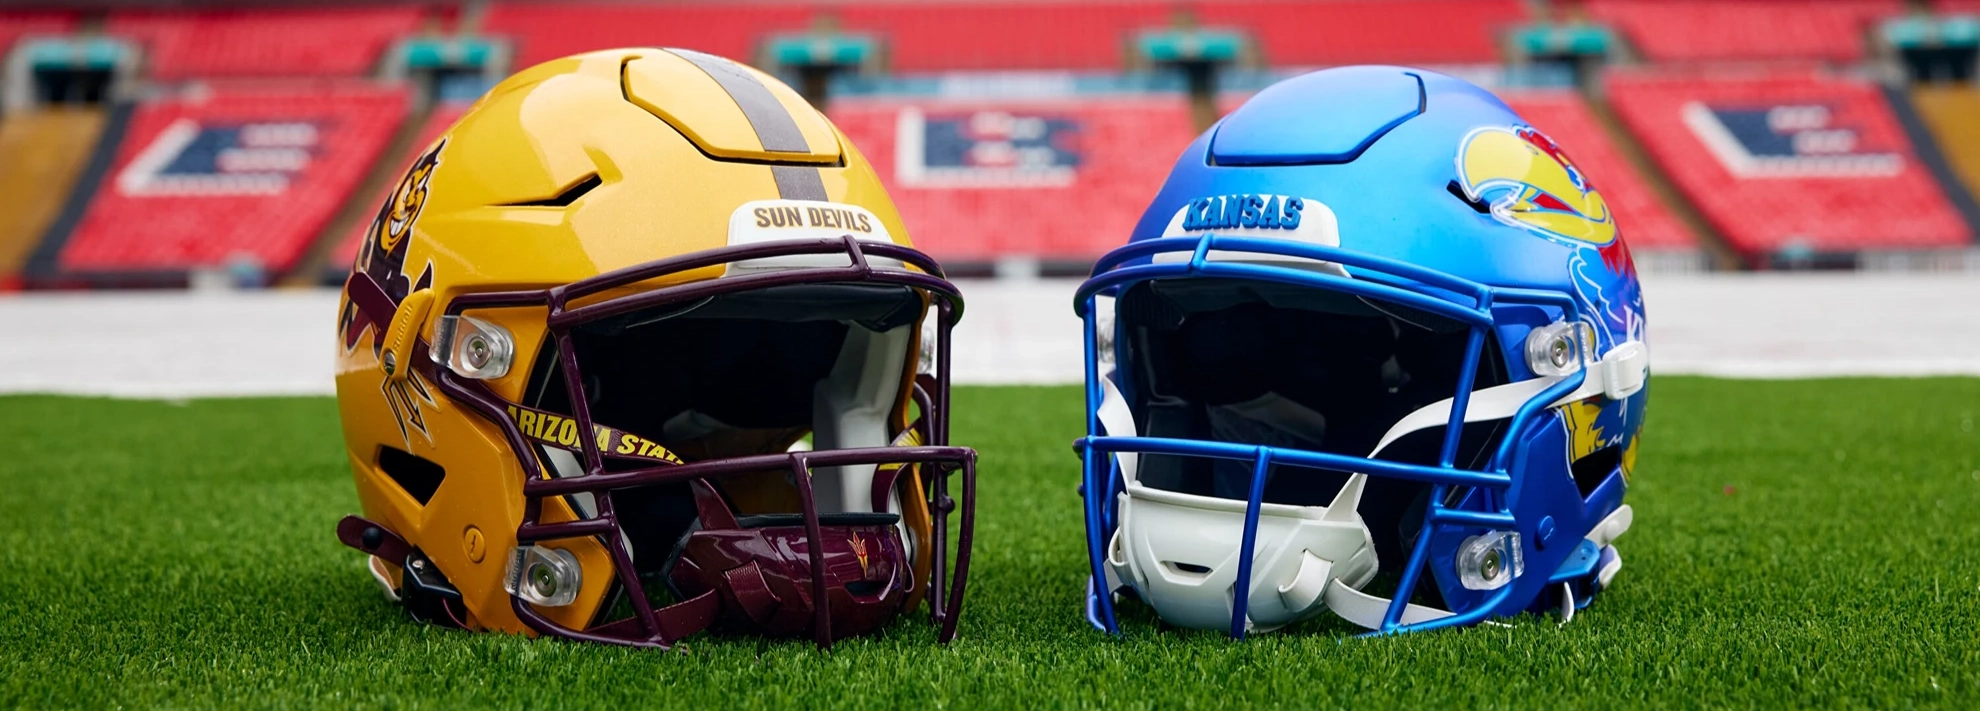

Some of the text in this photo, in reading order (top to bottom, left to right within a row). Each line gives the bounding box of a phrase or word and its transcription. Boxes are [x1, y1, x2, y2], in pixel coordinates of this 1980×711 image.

[754, 206, 873, 234] SUN DEVILS
[1182, 194, 1304, 231] KANSAS
[616, 433, 686, 466] STAT
